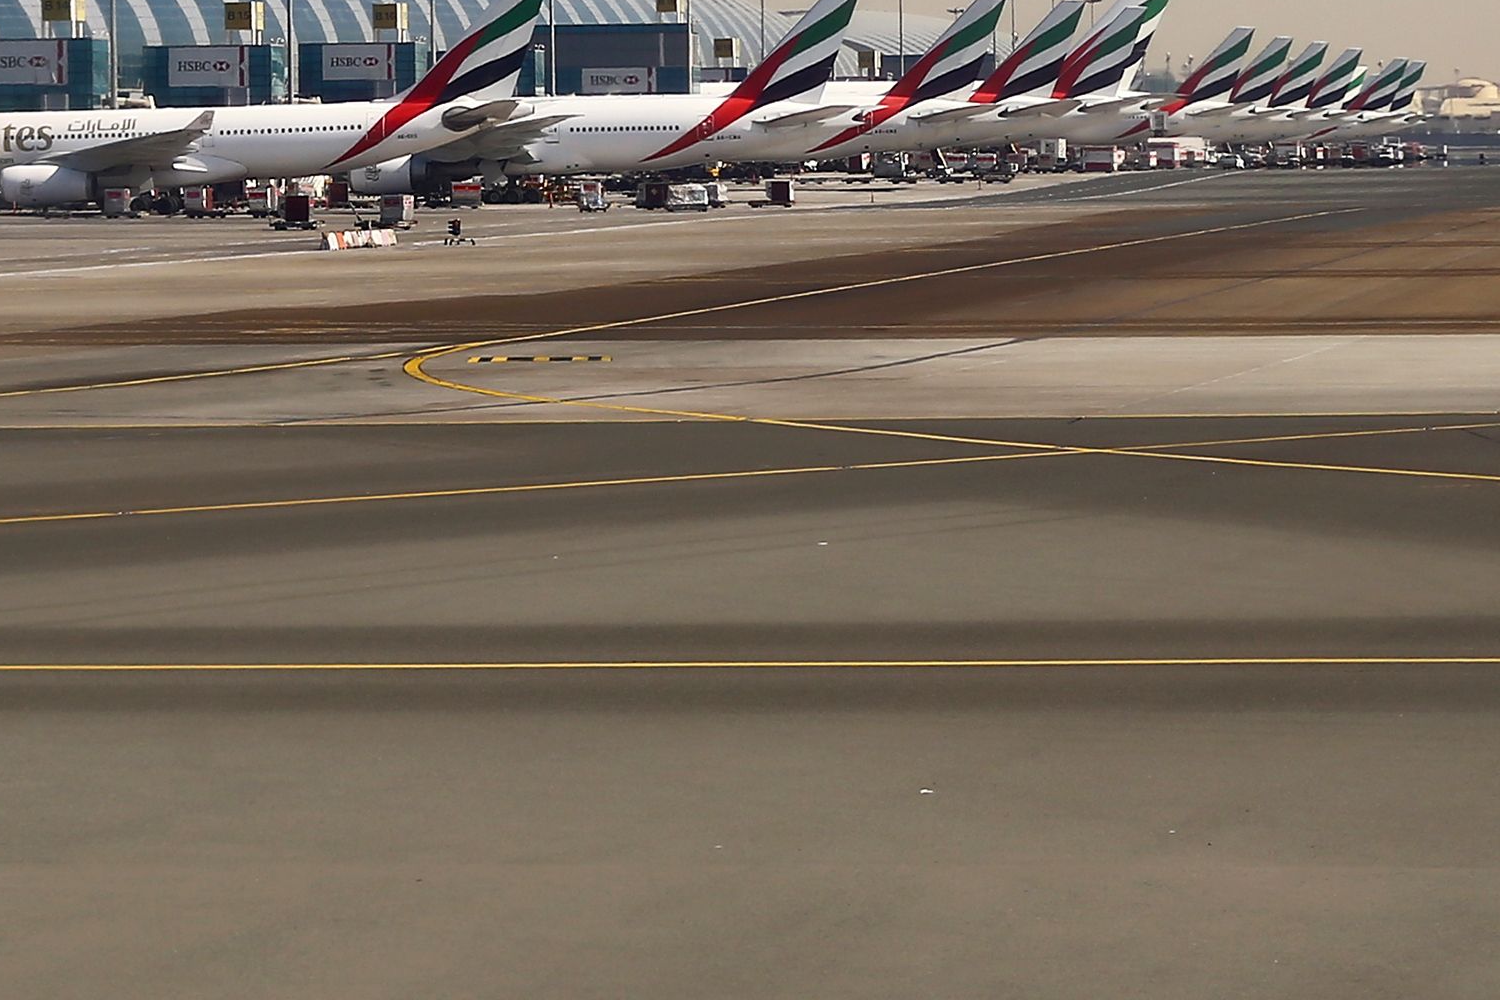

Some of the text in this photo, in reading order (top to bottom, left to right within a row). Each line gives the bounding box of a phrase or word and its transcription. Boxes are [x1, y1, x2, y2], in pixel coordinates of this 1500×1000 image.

[177, 61, 212, 72] HSBC
[330, 57, 361, 67] HSBC
[590, 75, 621, 86] HSBC
